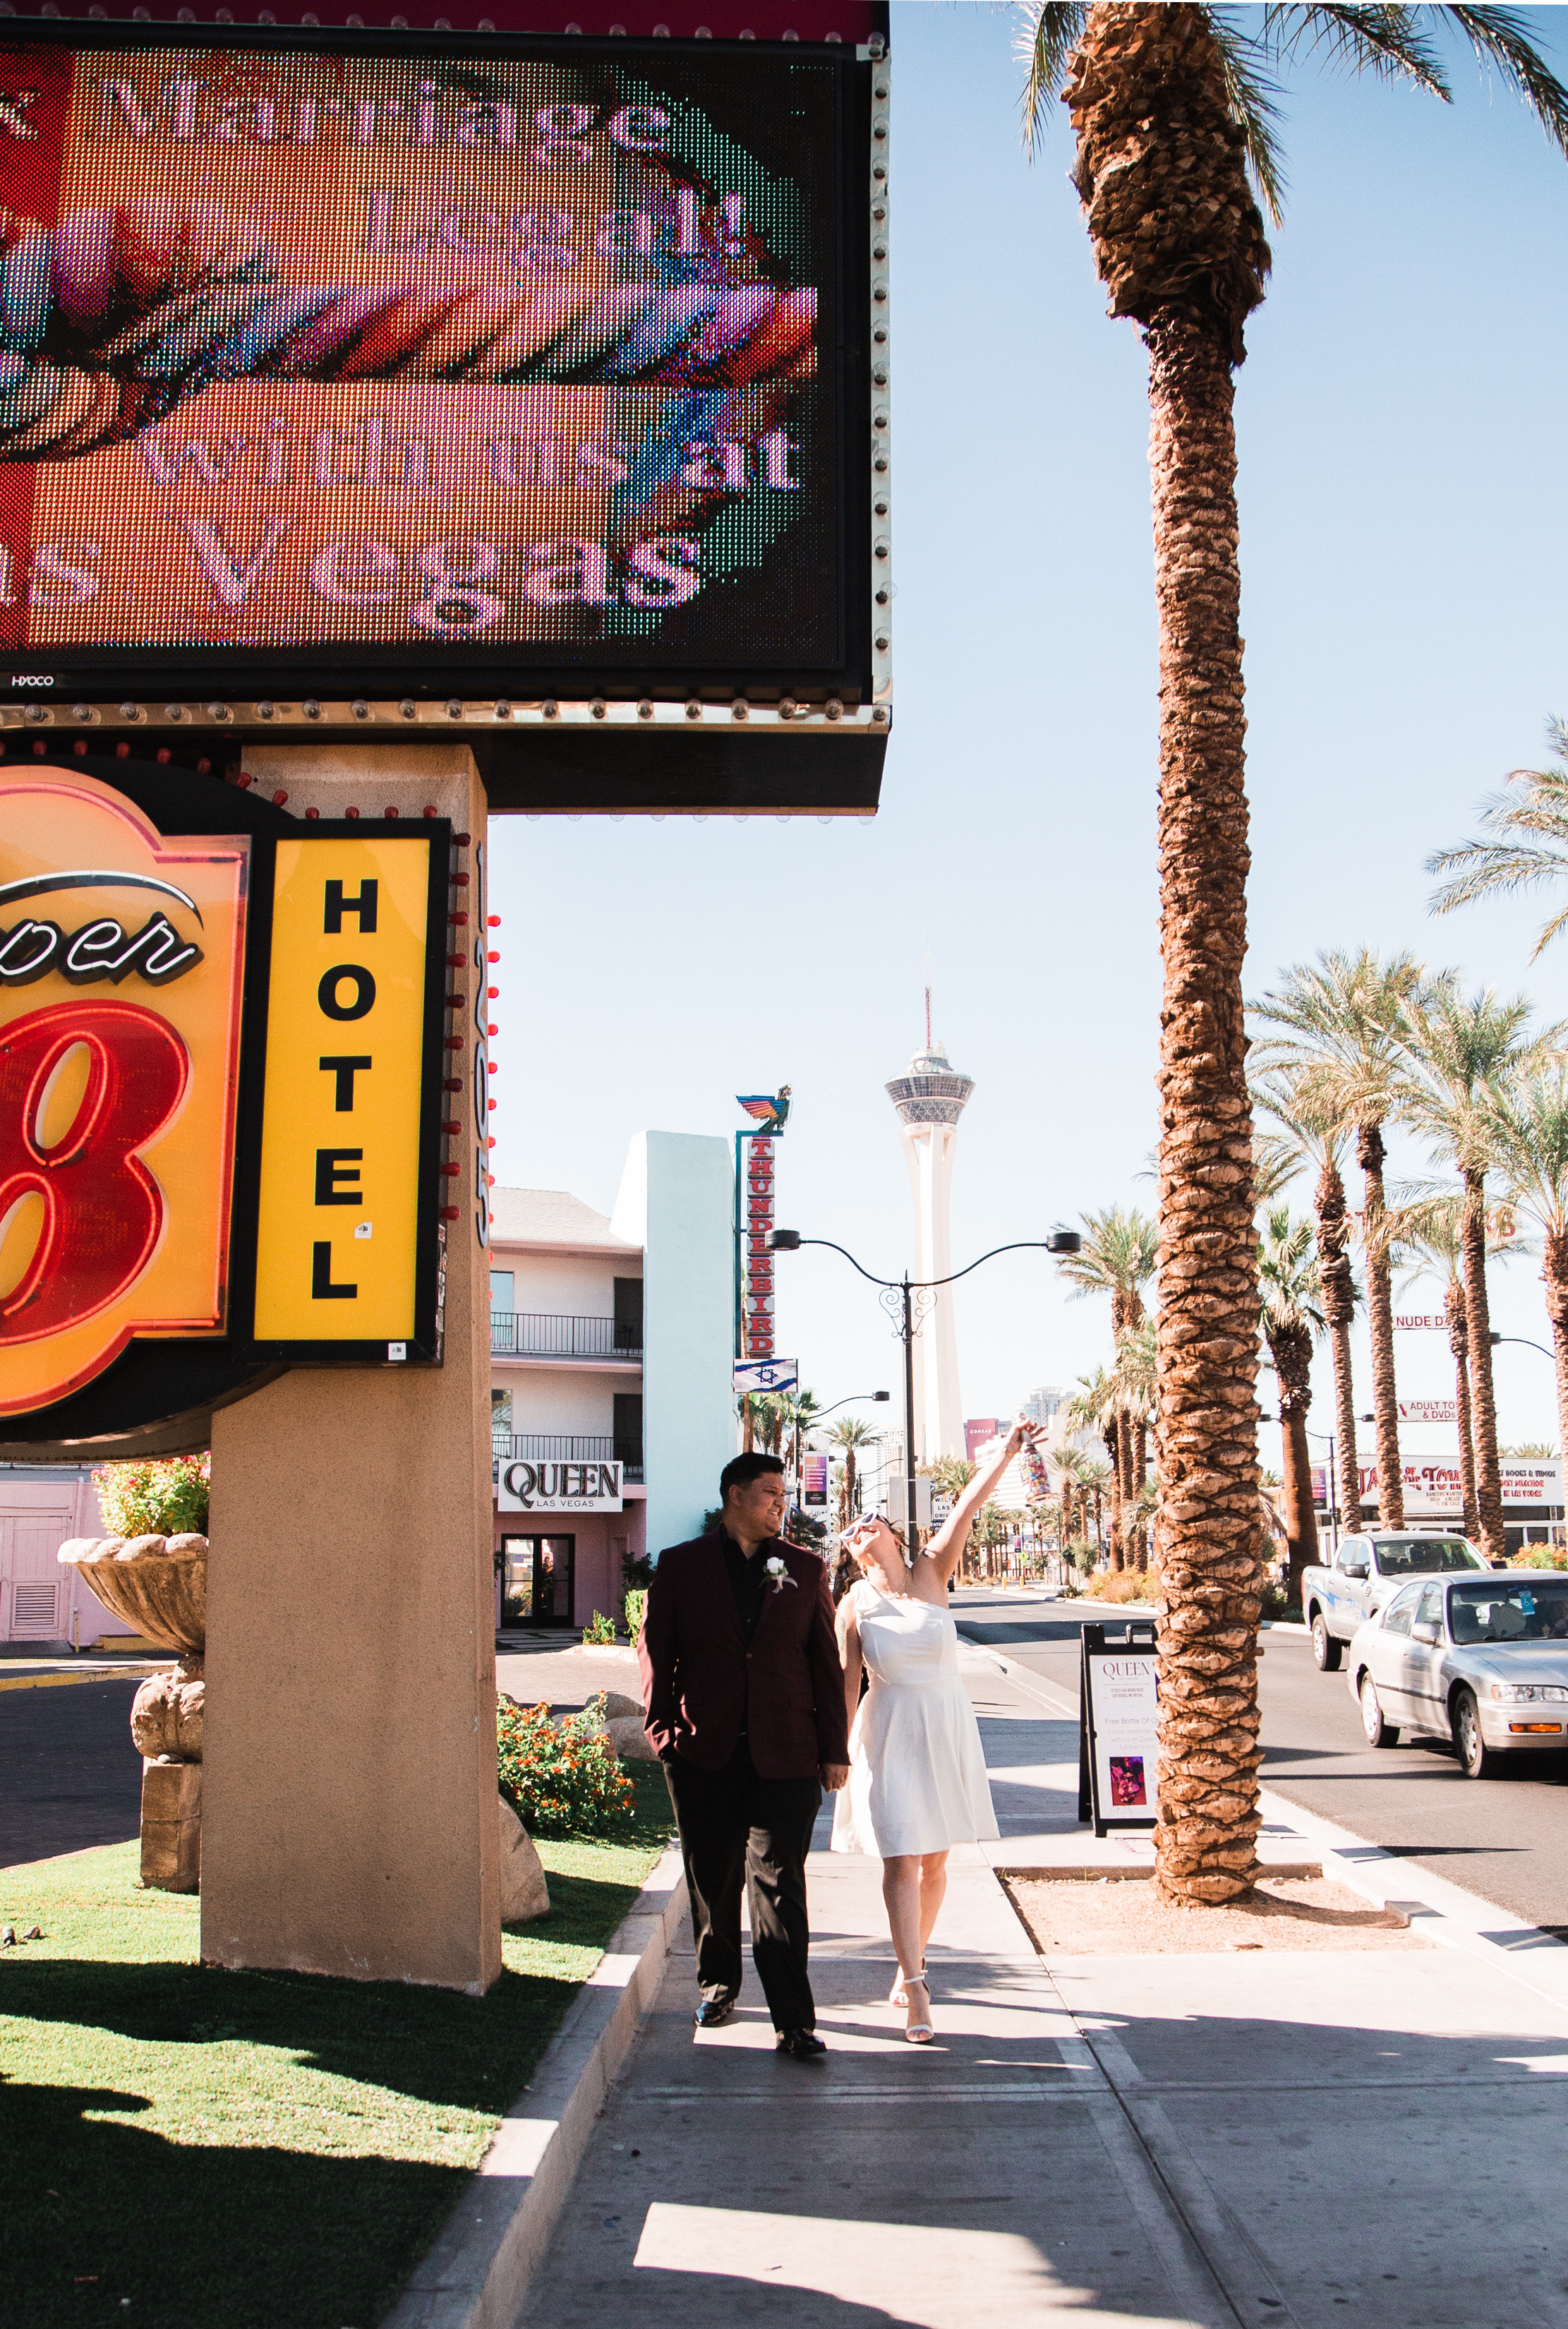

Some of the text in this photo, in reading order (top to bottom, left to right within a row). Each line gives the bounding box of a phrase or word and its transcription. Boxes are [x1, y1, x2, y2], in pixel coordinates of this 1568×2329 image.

[90, 75, 673, 167] Marriage
[359, 185, 747, 270] Legal!
[139, 411, 802, 491] with us at
[171, 513, 702, 634] Vegas
[11, 675, 54, 686] HYOCO
[474, 840, 489, 1248] 1205
[311, 879, 380, 1299] HOTEL
[749, 1141, 773, 1351] THUNDERBIRD
[1397, 1316, 1431, 1326] NUDE
[1411, 1402, 1439, 1410] ADULT
[505, 1462, 619, 1508] QUEEN
[1405, 1467, 1416, 1475] OF
[1103, 1661, 1150, 1680] QUEEN
